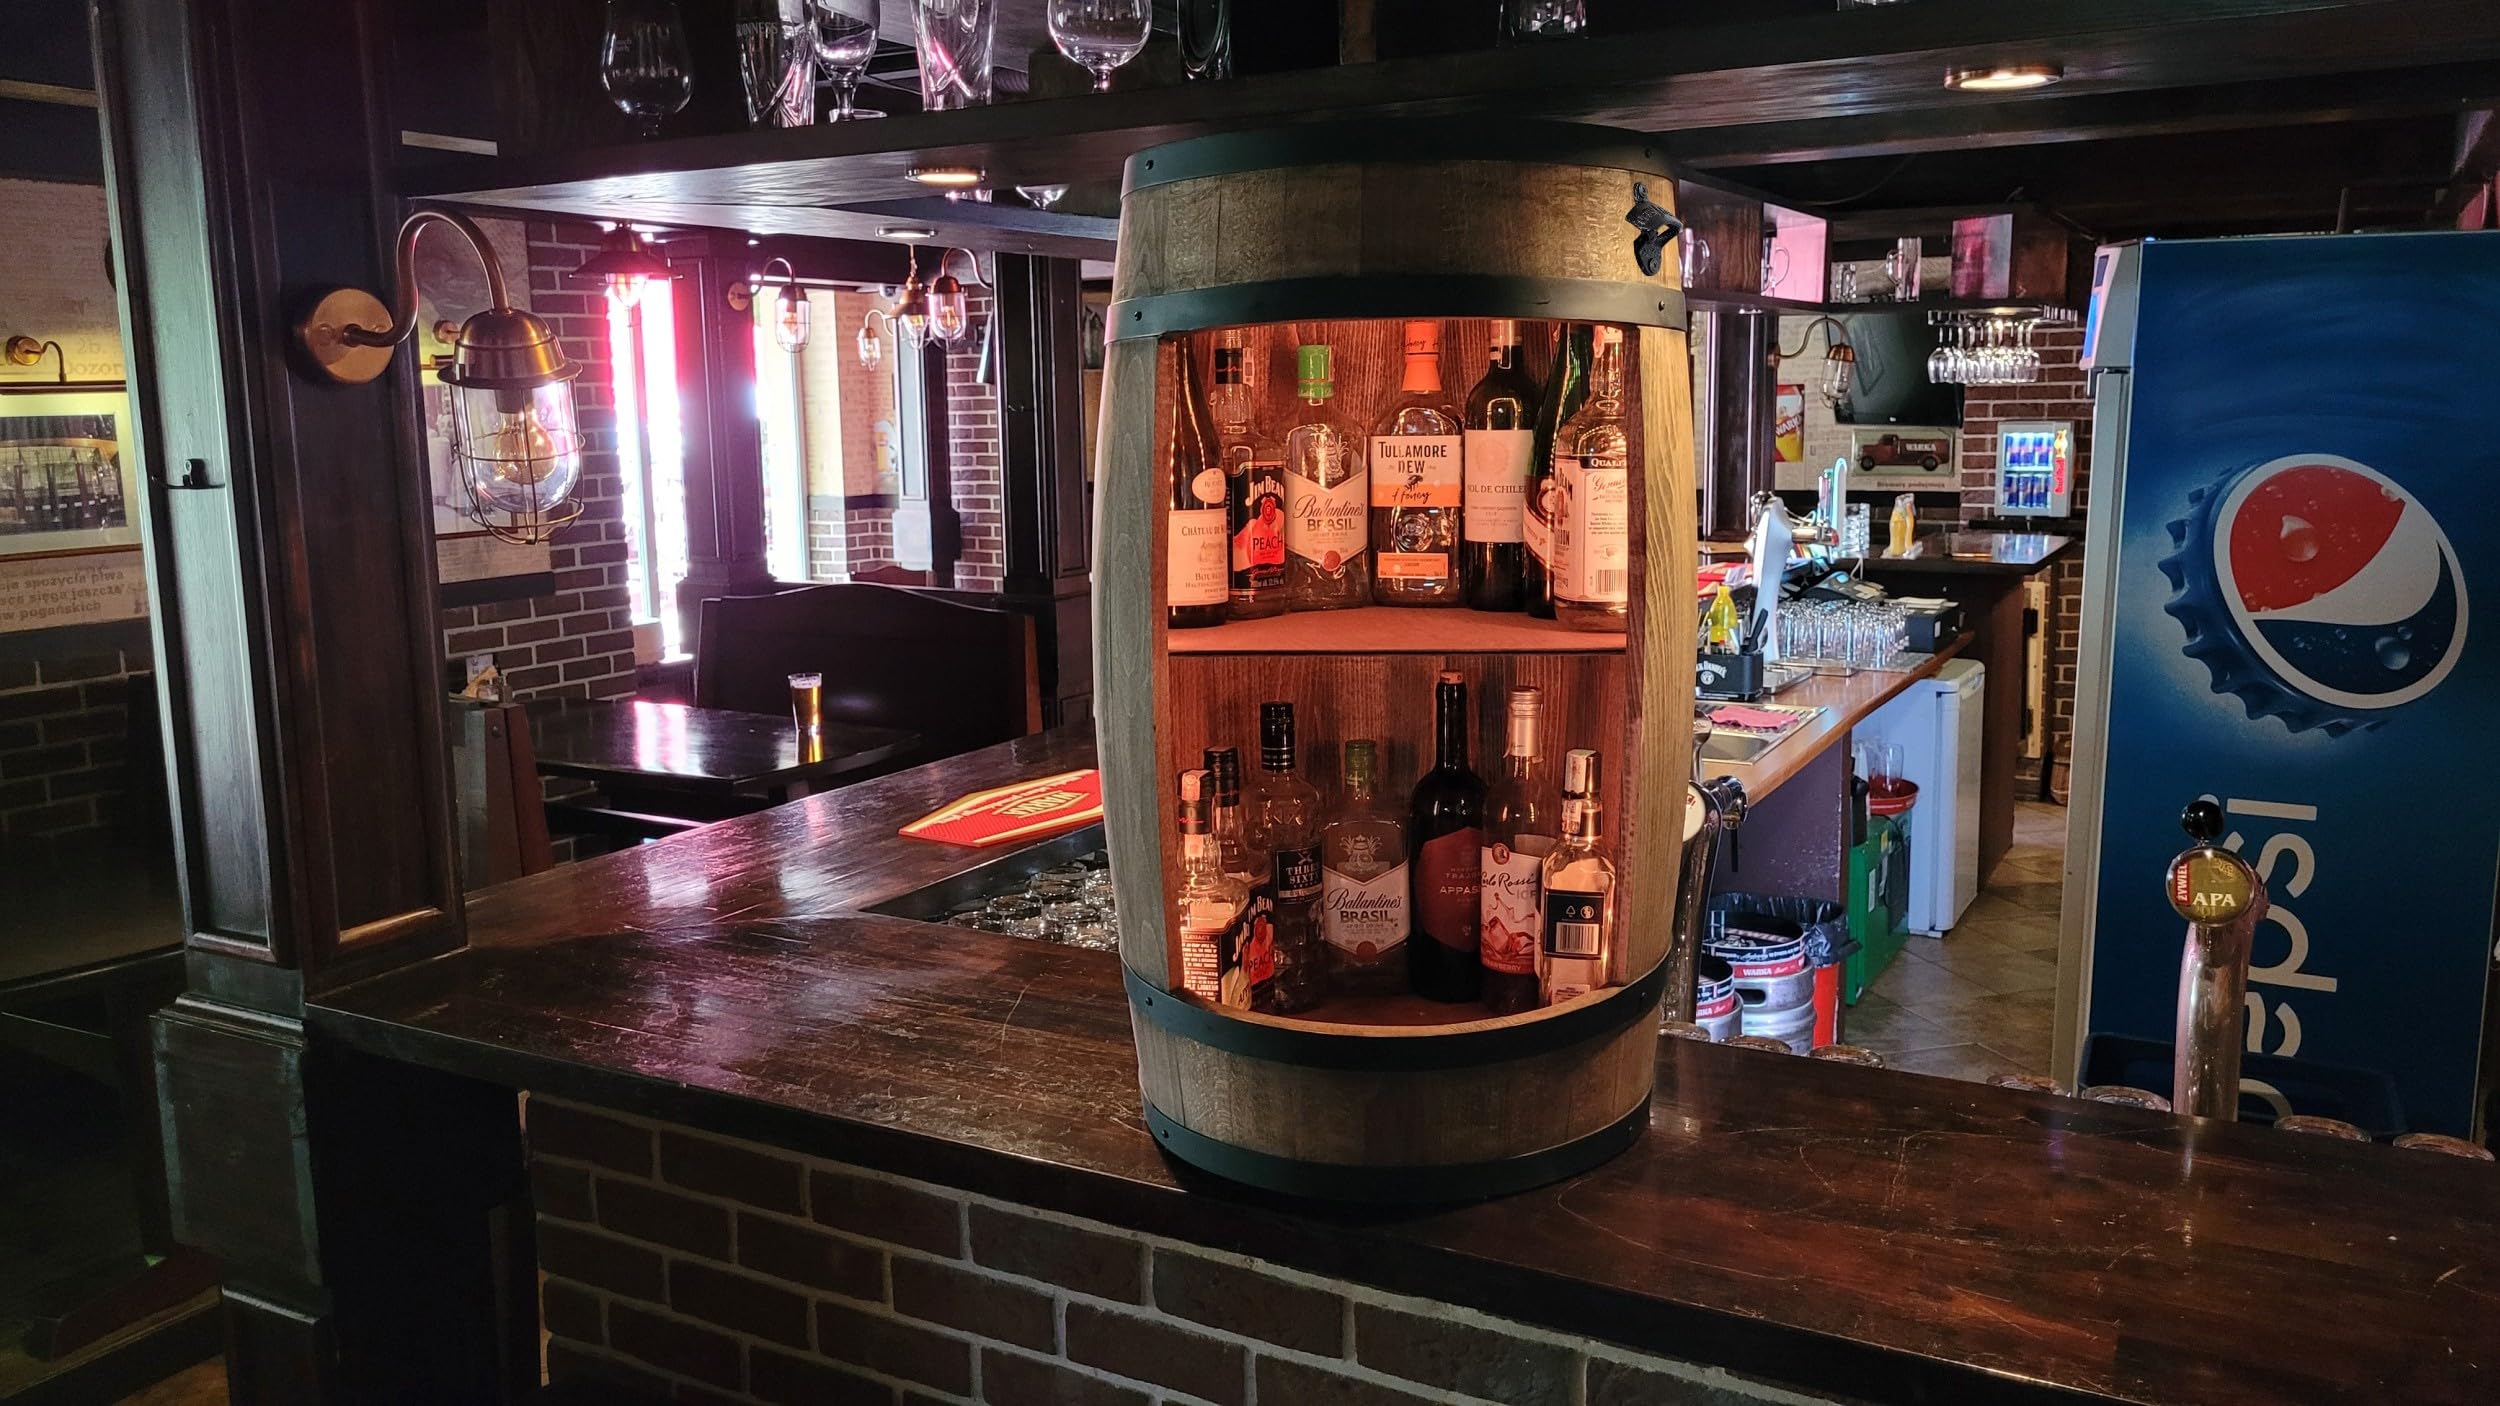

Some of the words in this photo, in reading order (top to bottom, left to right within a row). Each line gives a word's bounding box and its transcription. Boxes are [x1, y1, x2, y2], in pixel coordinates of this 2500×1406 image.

[1378, 441, 1447, 459] TULLAMORE
[1905, 443, 1936, 452] WARKA
[1398, 460, 1426, 474] DEW
[1245, 481, 1265, 506] JIM
[1392, 488, 1433, 506] Honey
[1480, 485, 1493, 494] DE
[1293, 494, 1365, 519] Ballantine's
[1306, 518, 1357, 532] BRASIL
[1253, 531, 1283, 551] PEACH
[1327, 887, 1403, 911] Ballantine's
[2192, 892, 2236, 907] APA
[1340, 911, 1393, 923] BRASIL
[1742, 967, 1773, 977] WARKA
